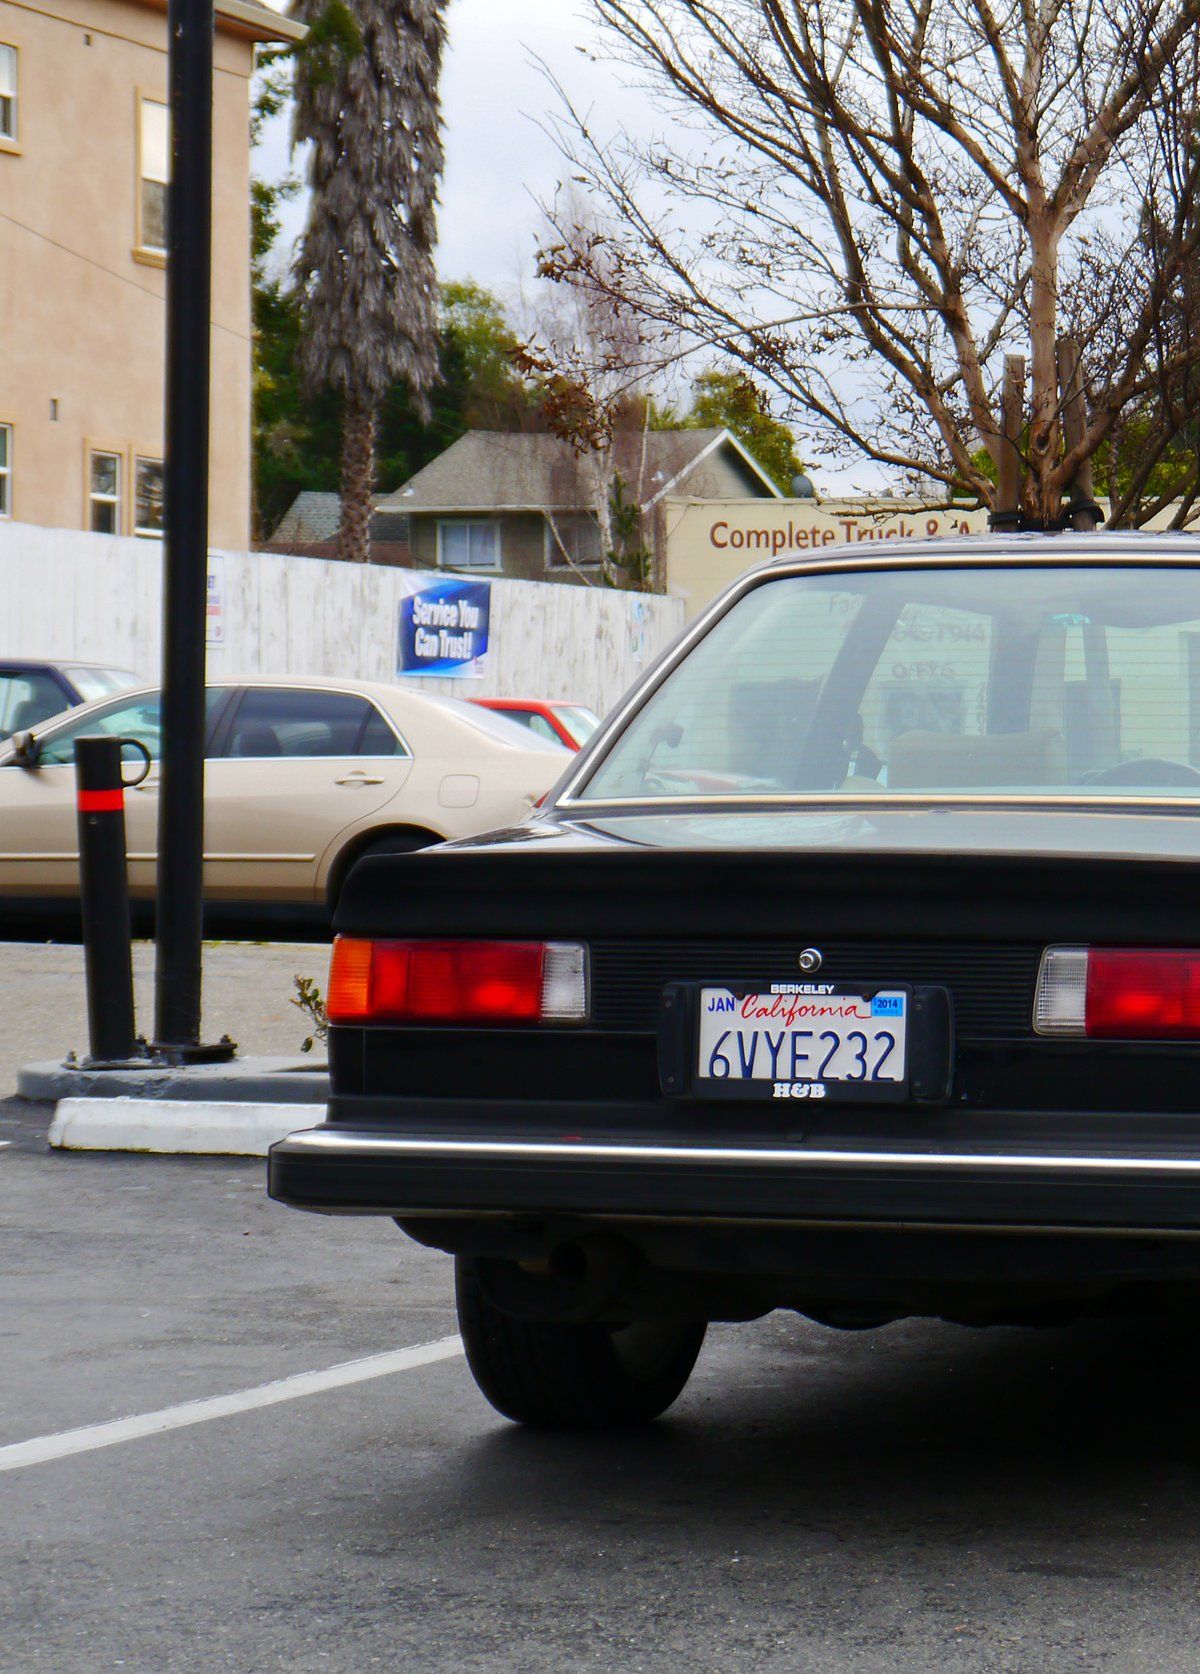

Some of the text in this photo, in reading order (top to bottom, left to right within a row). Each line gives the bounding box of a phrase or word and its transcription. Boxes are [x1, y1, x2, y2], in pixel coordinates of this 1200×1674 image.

[709, 520, 836, 557] Complete
[413, 595, 479, 629] Service You
[415, 627, 473, 660] Can Trust!
[707, 997, 735, 1012] JAN
[771, 984, 834, 994] BERKELEY
[877, 999, 898, 1008] 2014
[741, 994, 872, 1027] California
[709, 1031, 896, 1081] 6VYE232
[773, 1083, 826, 1099] H&B
